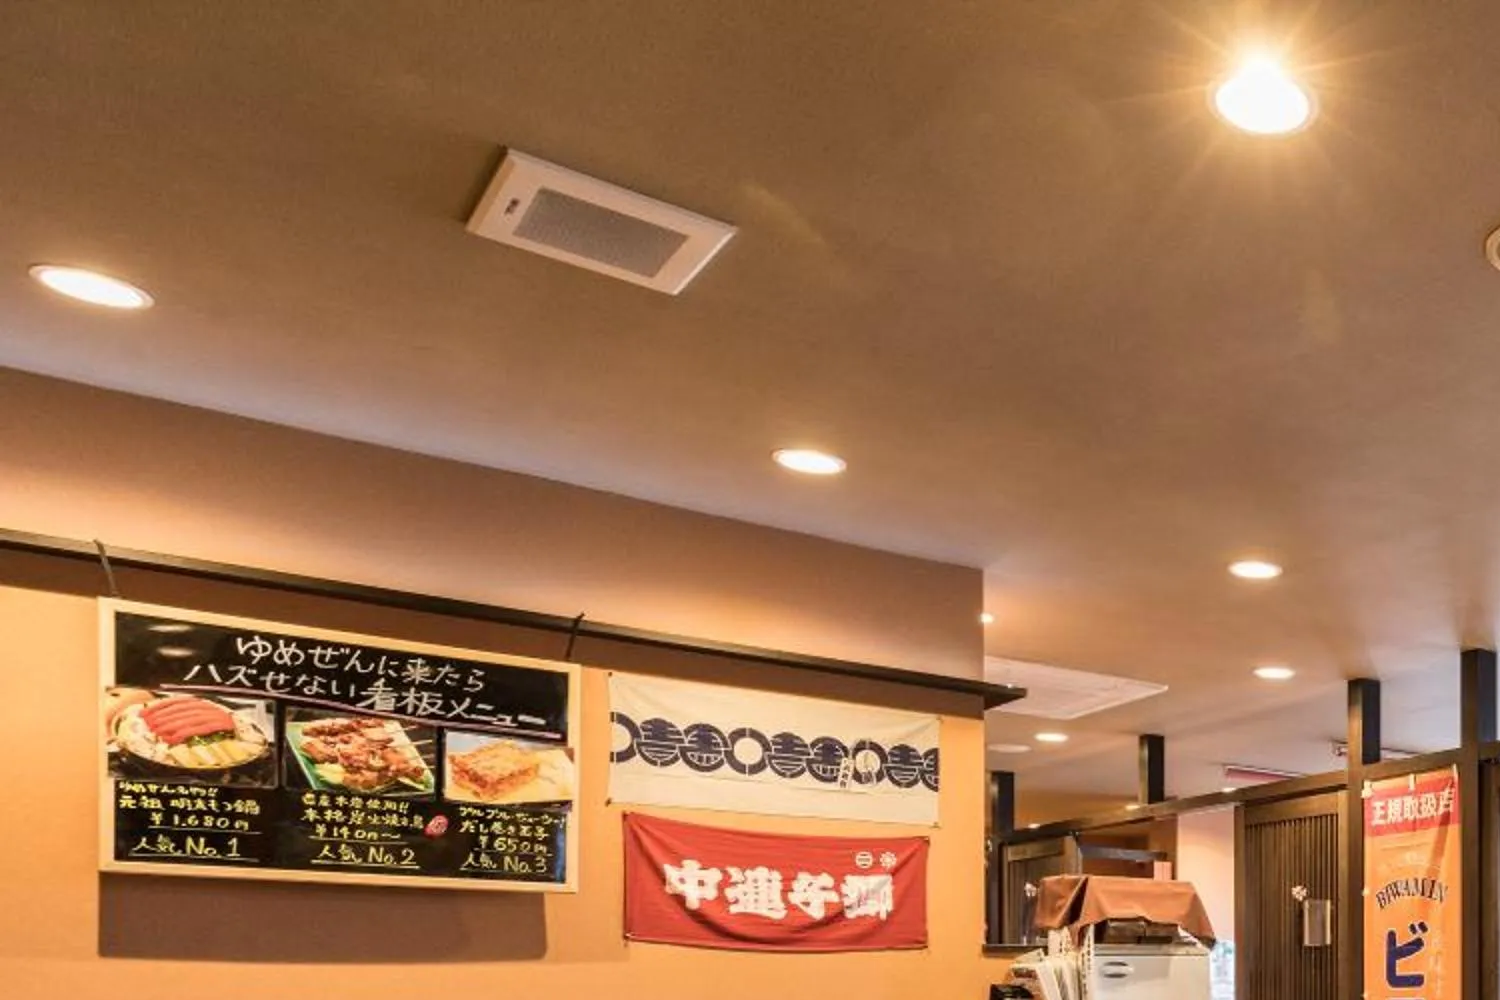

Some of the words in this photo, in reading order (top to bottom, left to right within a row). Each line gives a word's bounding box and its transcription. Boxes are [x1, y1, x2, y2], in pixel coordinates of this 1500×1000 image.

[236, 635, 486, 692] ゆめぜんに来たら
[184, 664, 547, 727] ハズせない看板メニュー
[1370, 785, 1455, 826] 正規取扱店
[1375, 878, 1449, 909] BIWAMIN
